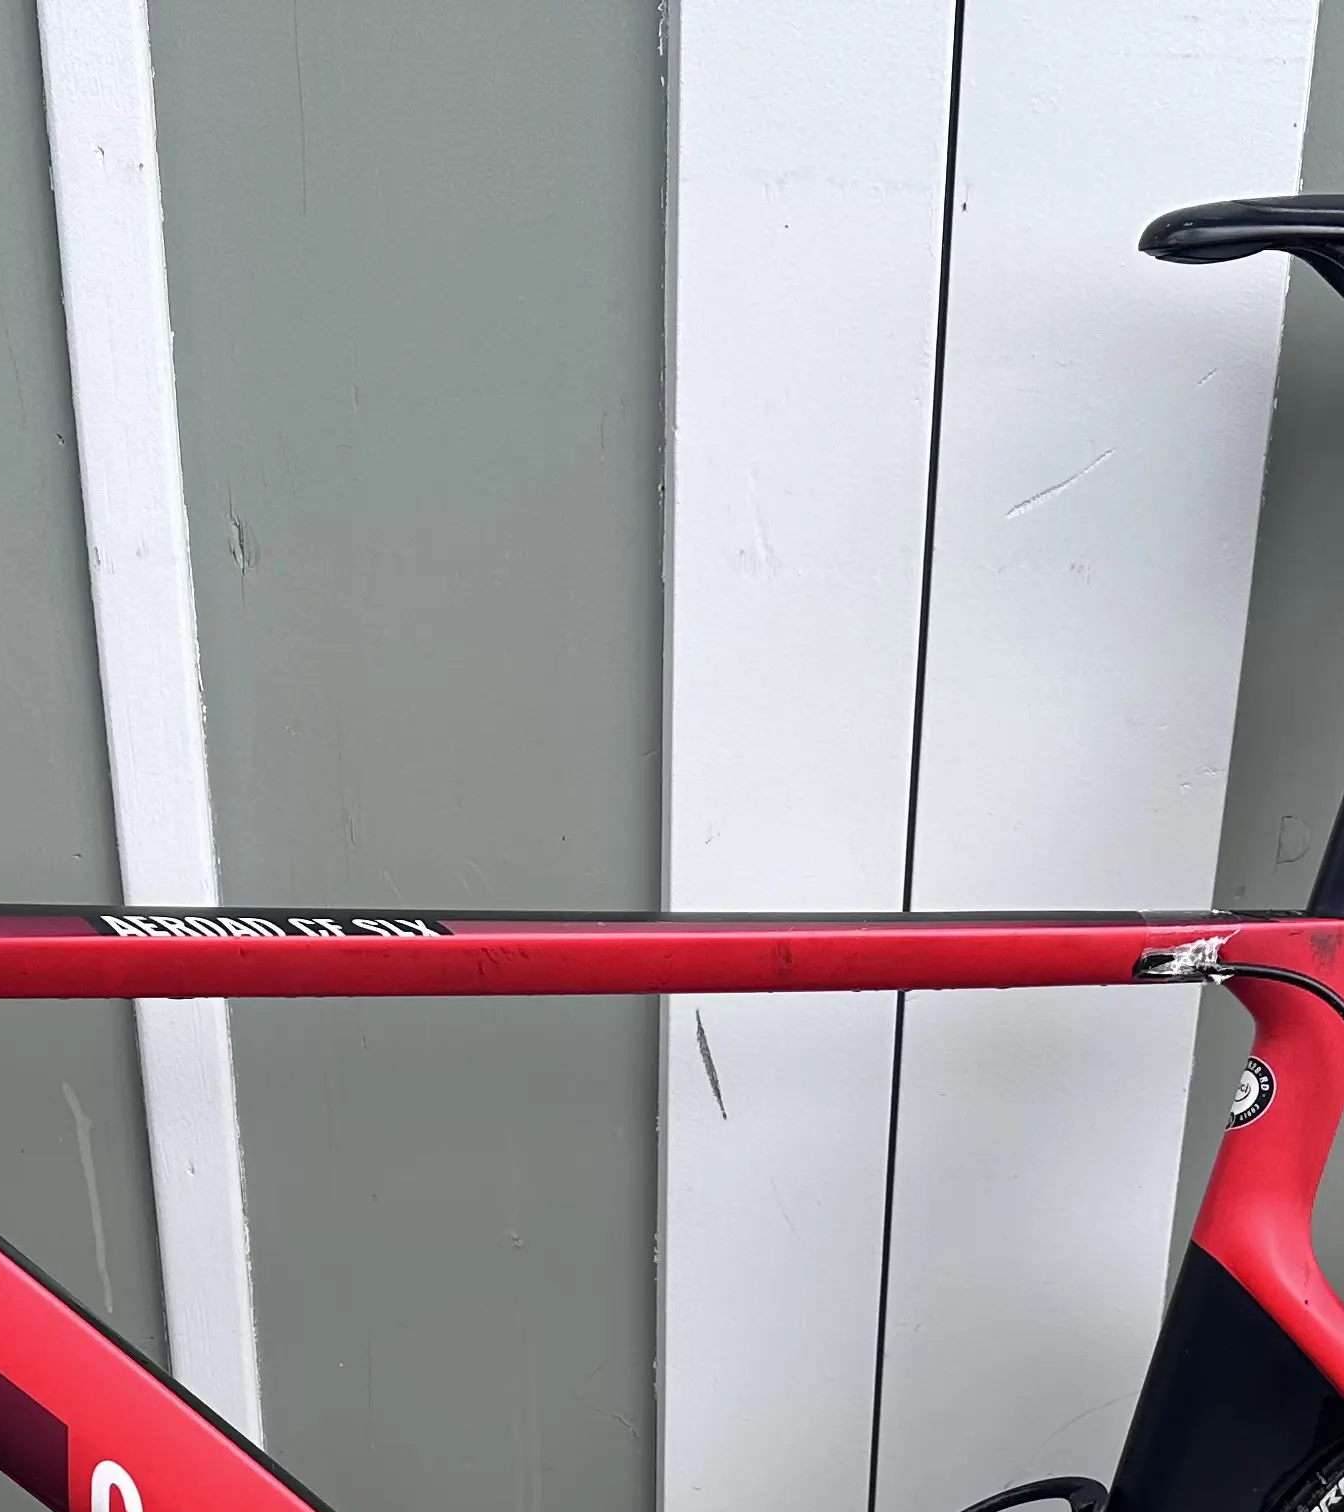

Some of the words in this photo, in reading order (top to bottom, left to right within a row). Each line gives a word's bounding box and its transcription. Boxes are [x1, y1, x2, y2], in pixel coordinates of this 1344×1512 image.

[100, 914, 287, 938] AEROAD
[287, 916, 346, 938] CF
[351, 917, 442, 938] SLX
